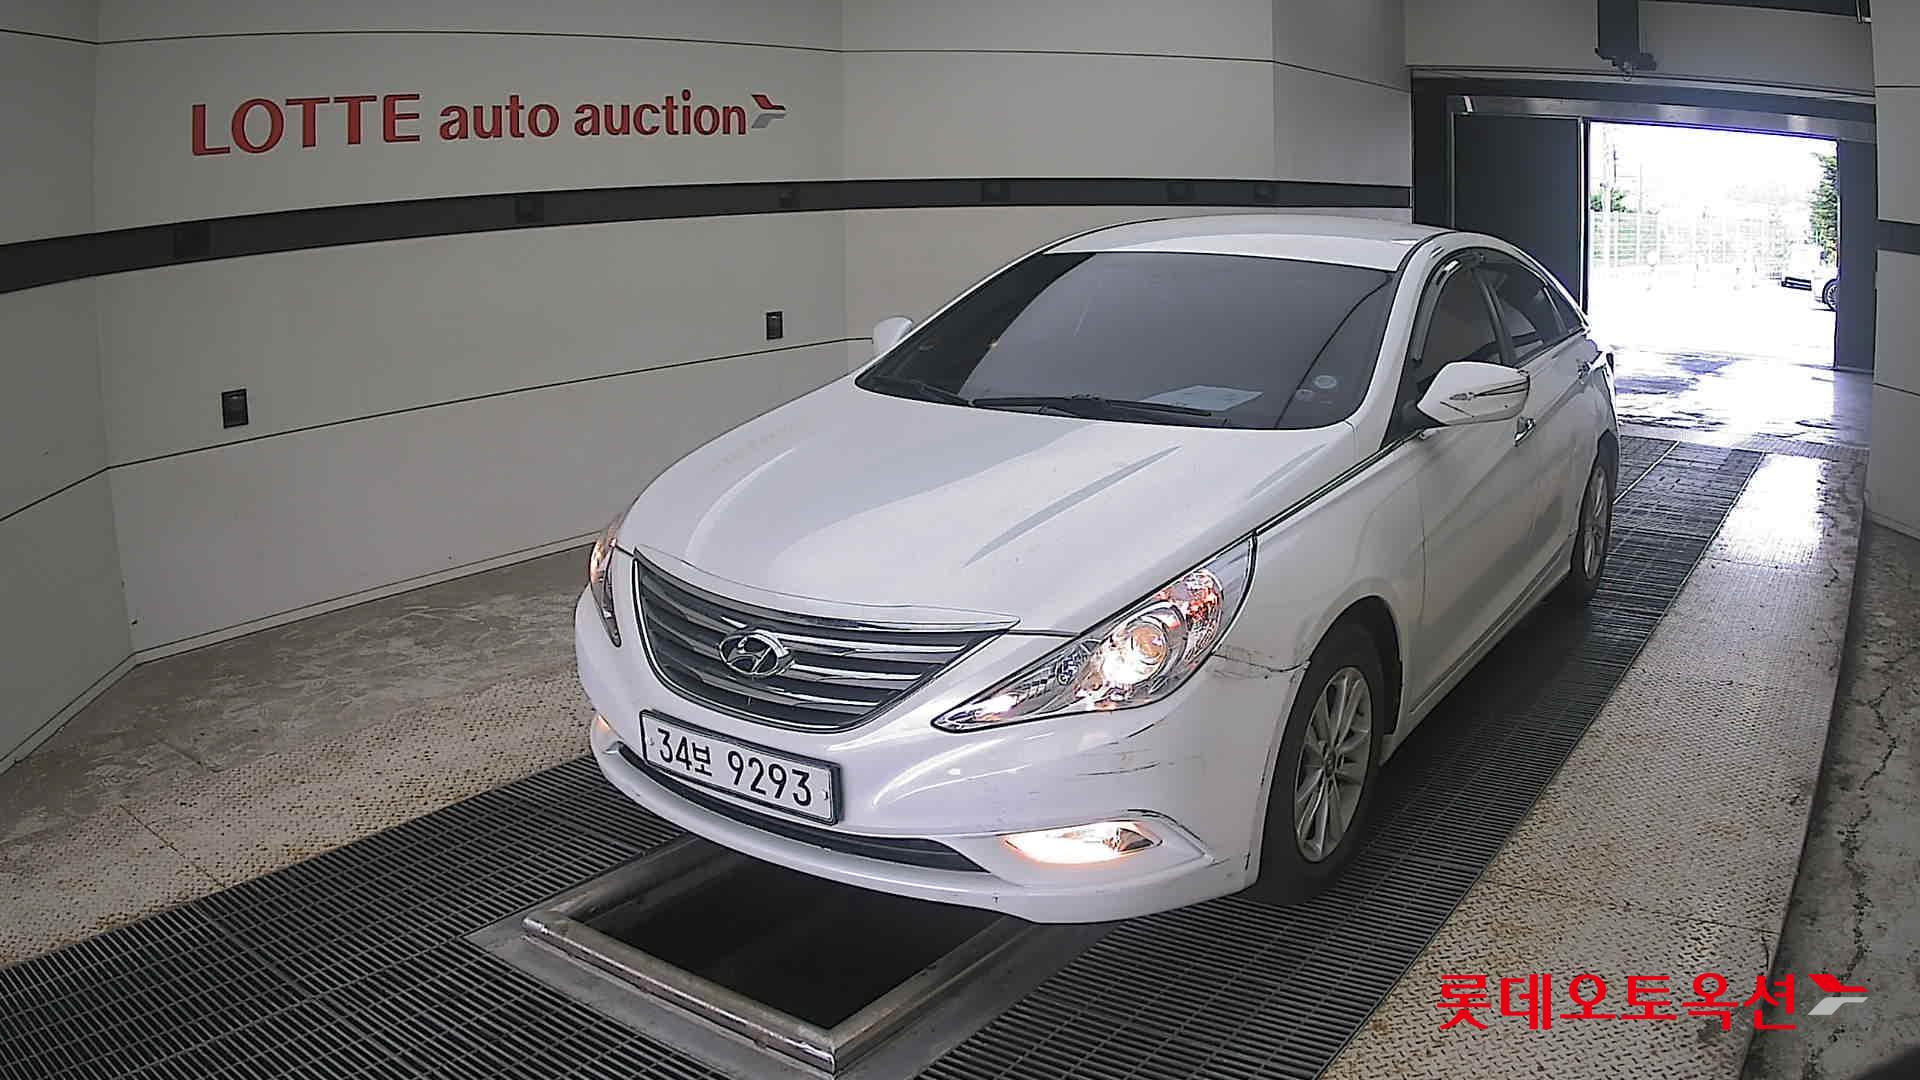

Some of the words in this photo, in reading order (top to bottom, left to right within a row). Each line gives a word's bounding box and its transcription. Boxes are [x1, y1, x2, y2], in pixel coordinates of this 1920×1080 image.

[192, 94, 421, 156] LOTTE
[439, 95, 560, 140] auto
[574, 89, 747, 136] auction
[658, 727, 713, 777] 34보
[727, 750, 812, 807] 9293
